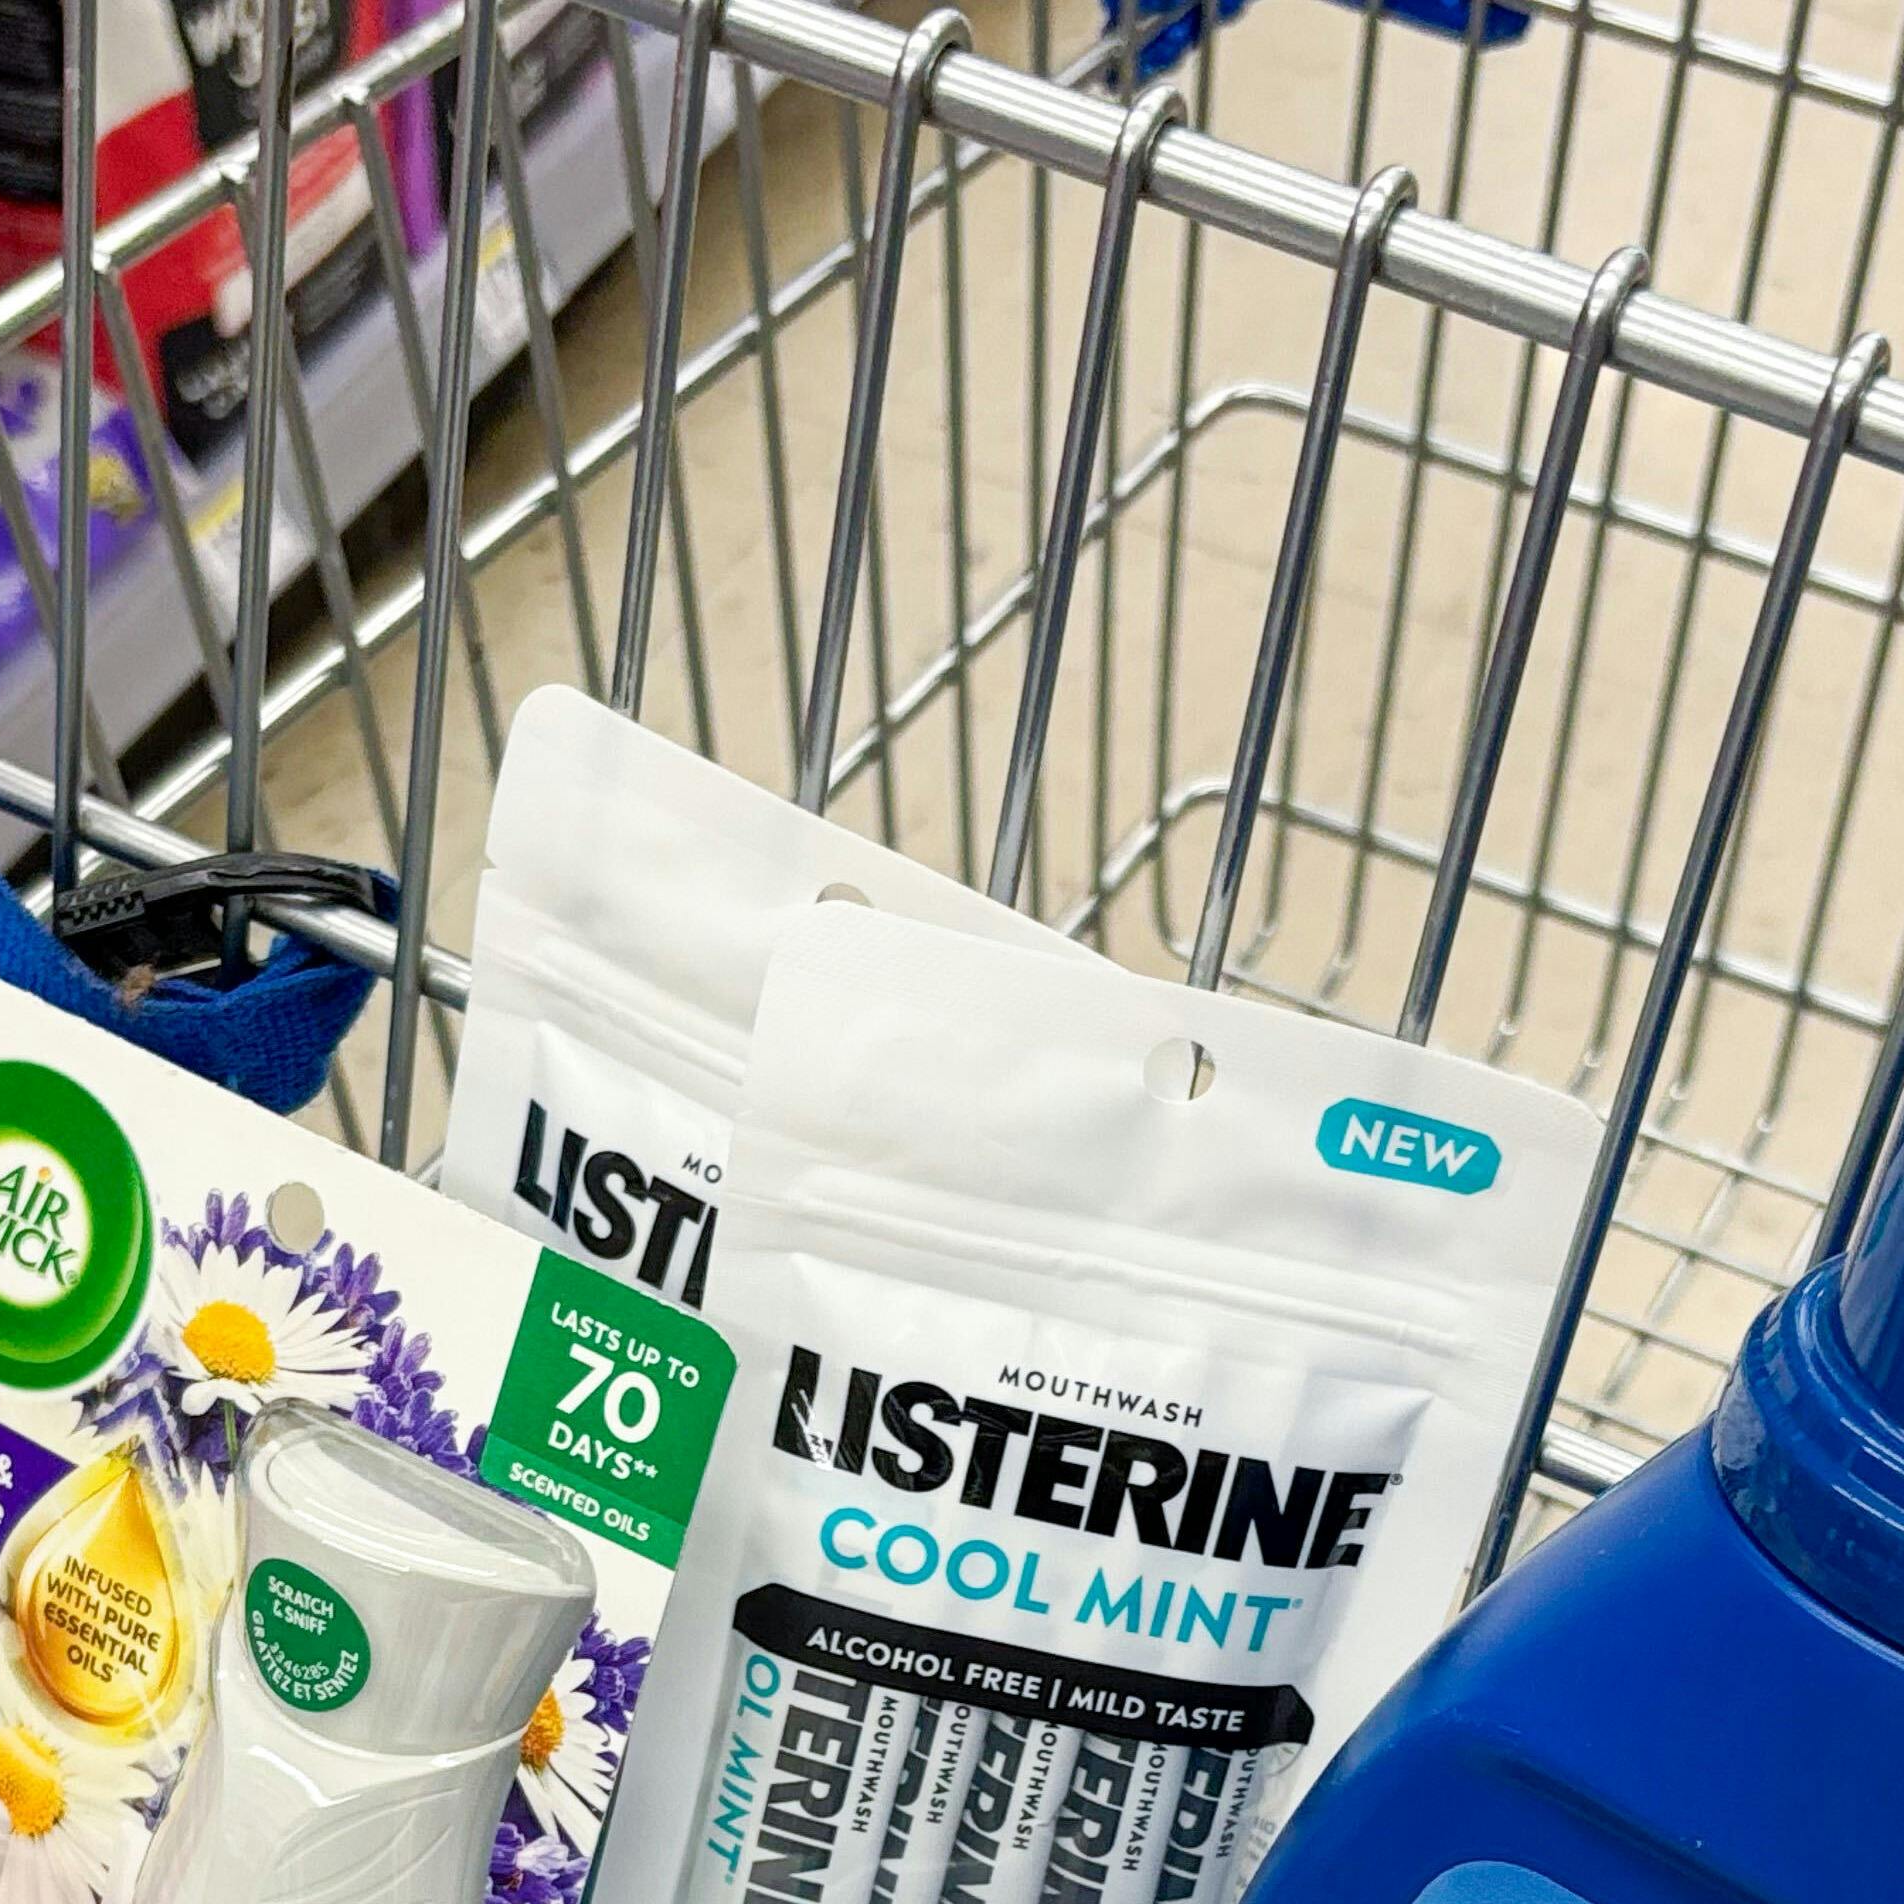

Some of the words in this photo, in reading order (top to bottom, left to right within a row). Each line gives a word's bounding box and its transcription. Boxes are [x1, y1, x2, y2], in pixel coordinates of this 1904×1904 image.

[1340, 1114, 1478, 1177] NEW
[550, 1301, 622, 1353] LASTS
[626, 1338, 660, 1367] UP
[666, 1355, 700, 1389] TO
[553, 1343, 662, 1445] 70
[999, 1364, 1203, 1428] MOUTHWASH
[772, 1345, 1391, 1571] LISTERINE
[508, 1461, 599, 1519] SCENTED
[603, 1506, 650, 1542] OILS
[47, 1573, 99, 1619] WITH
[104, 1607, 161, 1652] PURE
[64, 1556, 152, 1617] INFUSED
[268, 1575, 333, 1618] SCRATCH
[285, 1606, 327, 1635] SNIFF
[820, 1507, 1049, 1615] COOL
[1075, 1568, 1292, 1652] MINT
[44, 1601, 148, 1676] ESSENTIAL
[252, 1610, 292, 1692] GRATTEZ
[294, 1681, 311, 1701] ET
[313, 1650, 359, 1701] SENTEZ
[806, 1626, 956, 1682] ALCOHOL
[965, 1666, 1044, 1700] FREE
[1068, 1689, 1145, 1720] MILD
[1156, 1702, 1245, 1733] TASTE
[706, 1733, 764, 1877] MINT
[851, 1695, 900, 1835] MOUTHWASH
